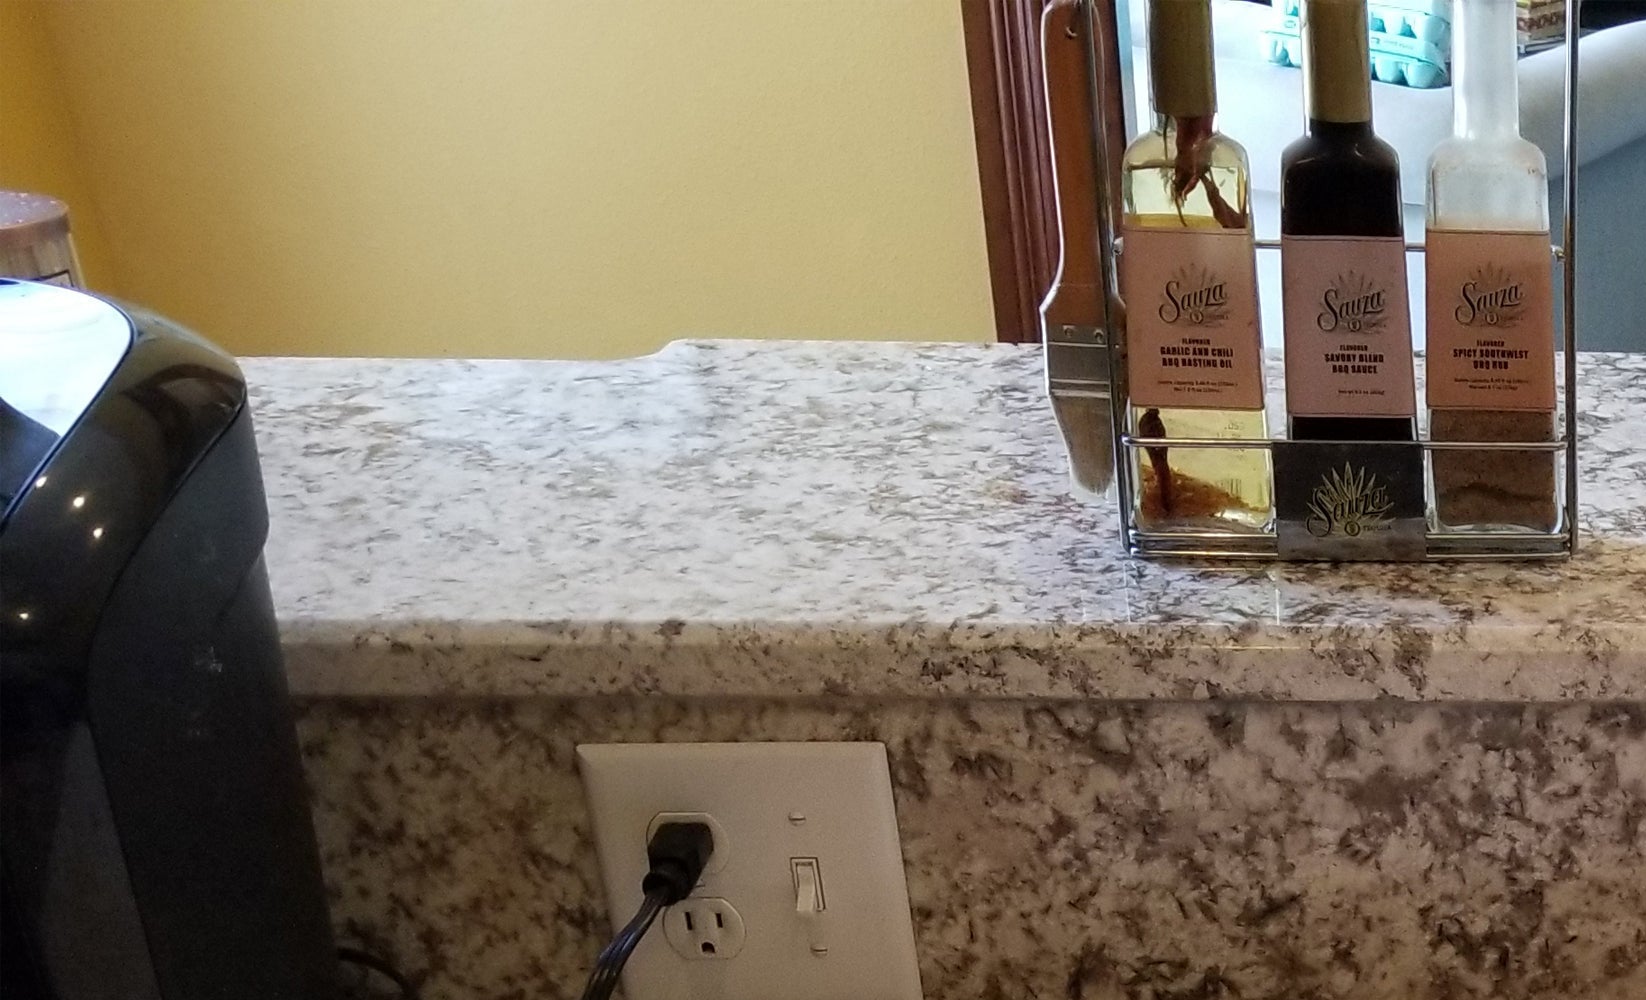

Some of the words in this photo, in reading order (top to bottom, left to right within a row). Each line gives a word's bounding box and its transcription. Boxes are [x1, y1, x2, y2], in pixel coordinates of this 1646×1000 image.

[1158, 280, 1228, 324] Sauza
[1455, 281, 1523, 326] Sauza
[1317, 288, 1386, 332] Sauza
[1160, 346, 1191, 356] GARLIC
[1192, 347, 1209, 357] AND
[1211, 348, 1234, 358] CHILI
[1324, 353, 1357, 362] SAVORY
[1453, 348, 1477, 358] SPICY
[1479, 349, 1529, 359] SOUTHWEST
[1181, 358, 1218, 368] BASTING
[1219, 359, 1233, 369] OIL
[1332, 364, 1349, 374] BBQ
[1350, 365, 1378, 374] SAUCE
[1306, 485, 1394, 538] Sauza
